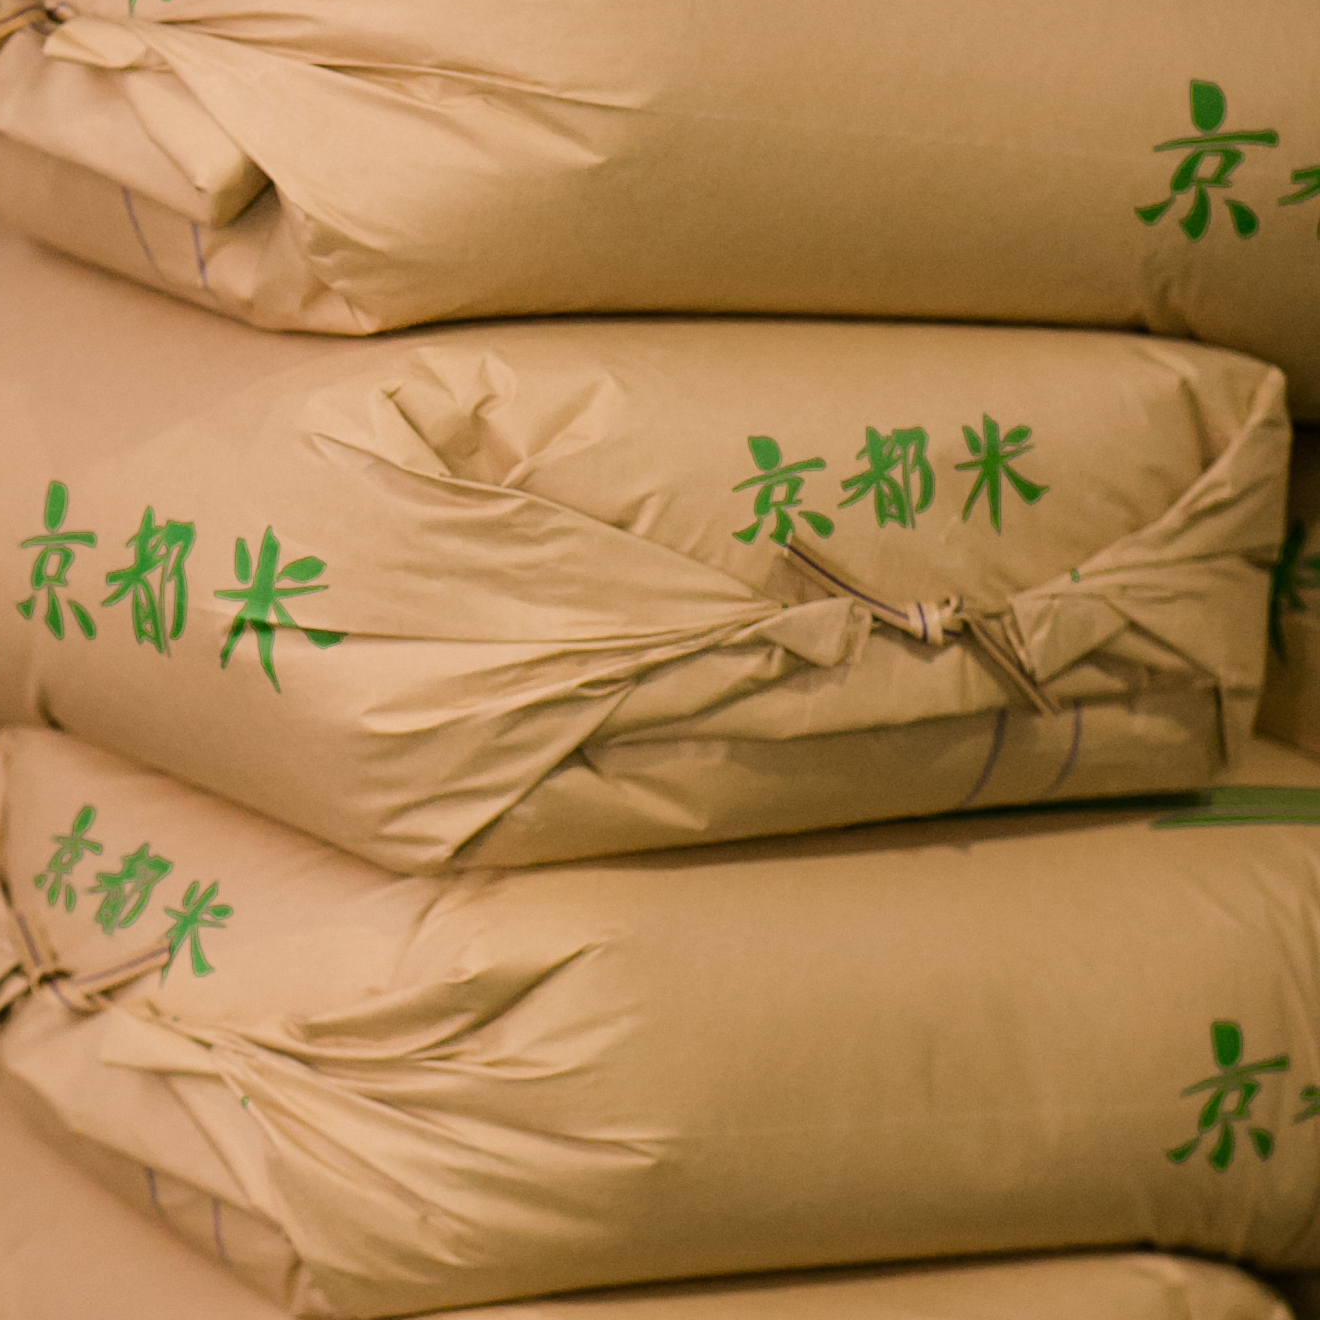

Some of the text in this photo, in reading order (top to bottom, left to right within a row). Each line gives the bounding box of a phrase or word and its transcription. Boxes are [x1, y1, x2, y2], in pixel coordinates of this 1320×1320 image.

[1134, 78, 1320, 243] 京
[731, 414, 1048, 548] 京都米
[17, 480, 345, 692] 京都米
[33, 804, 234, 986] 京都米
[1164, 1019, 1320, 1173] 京
